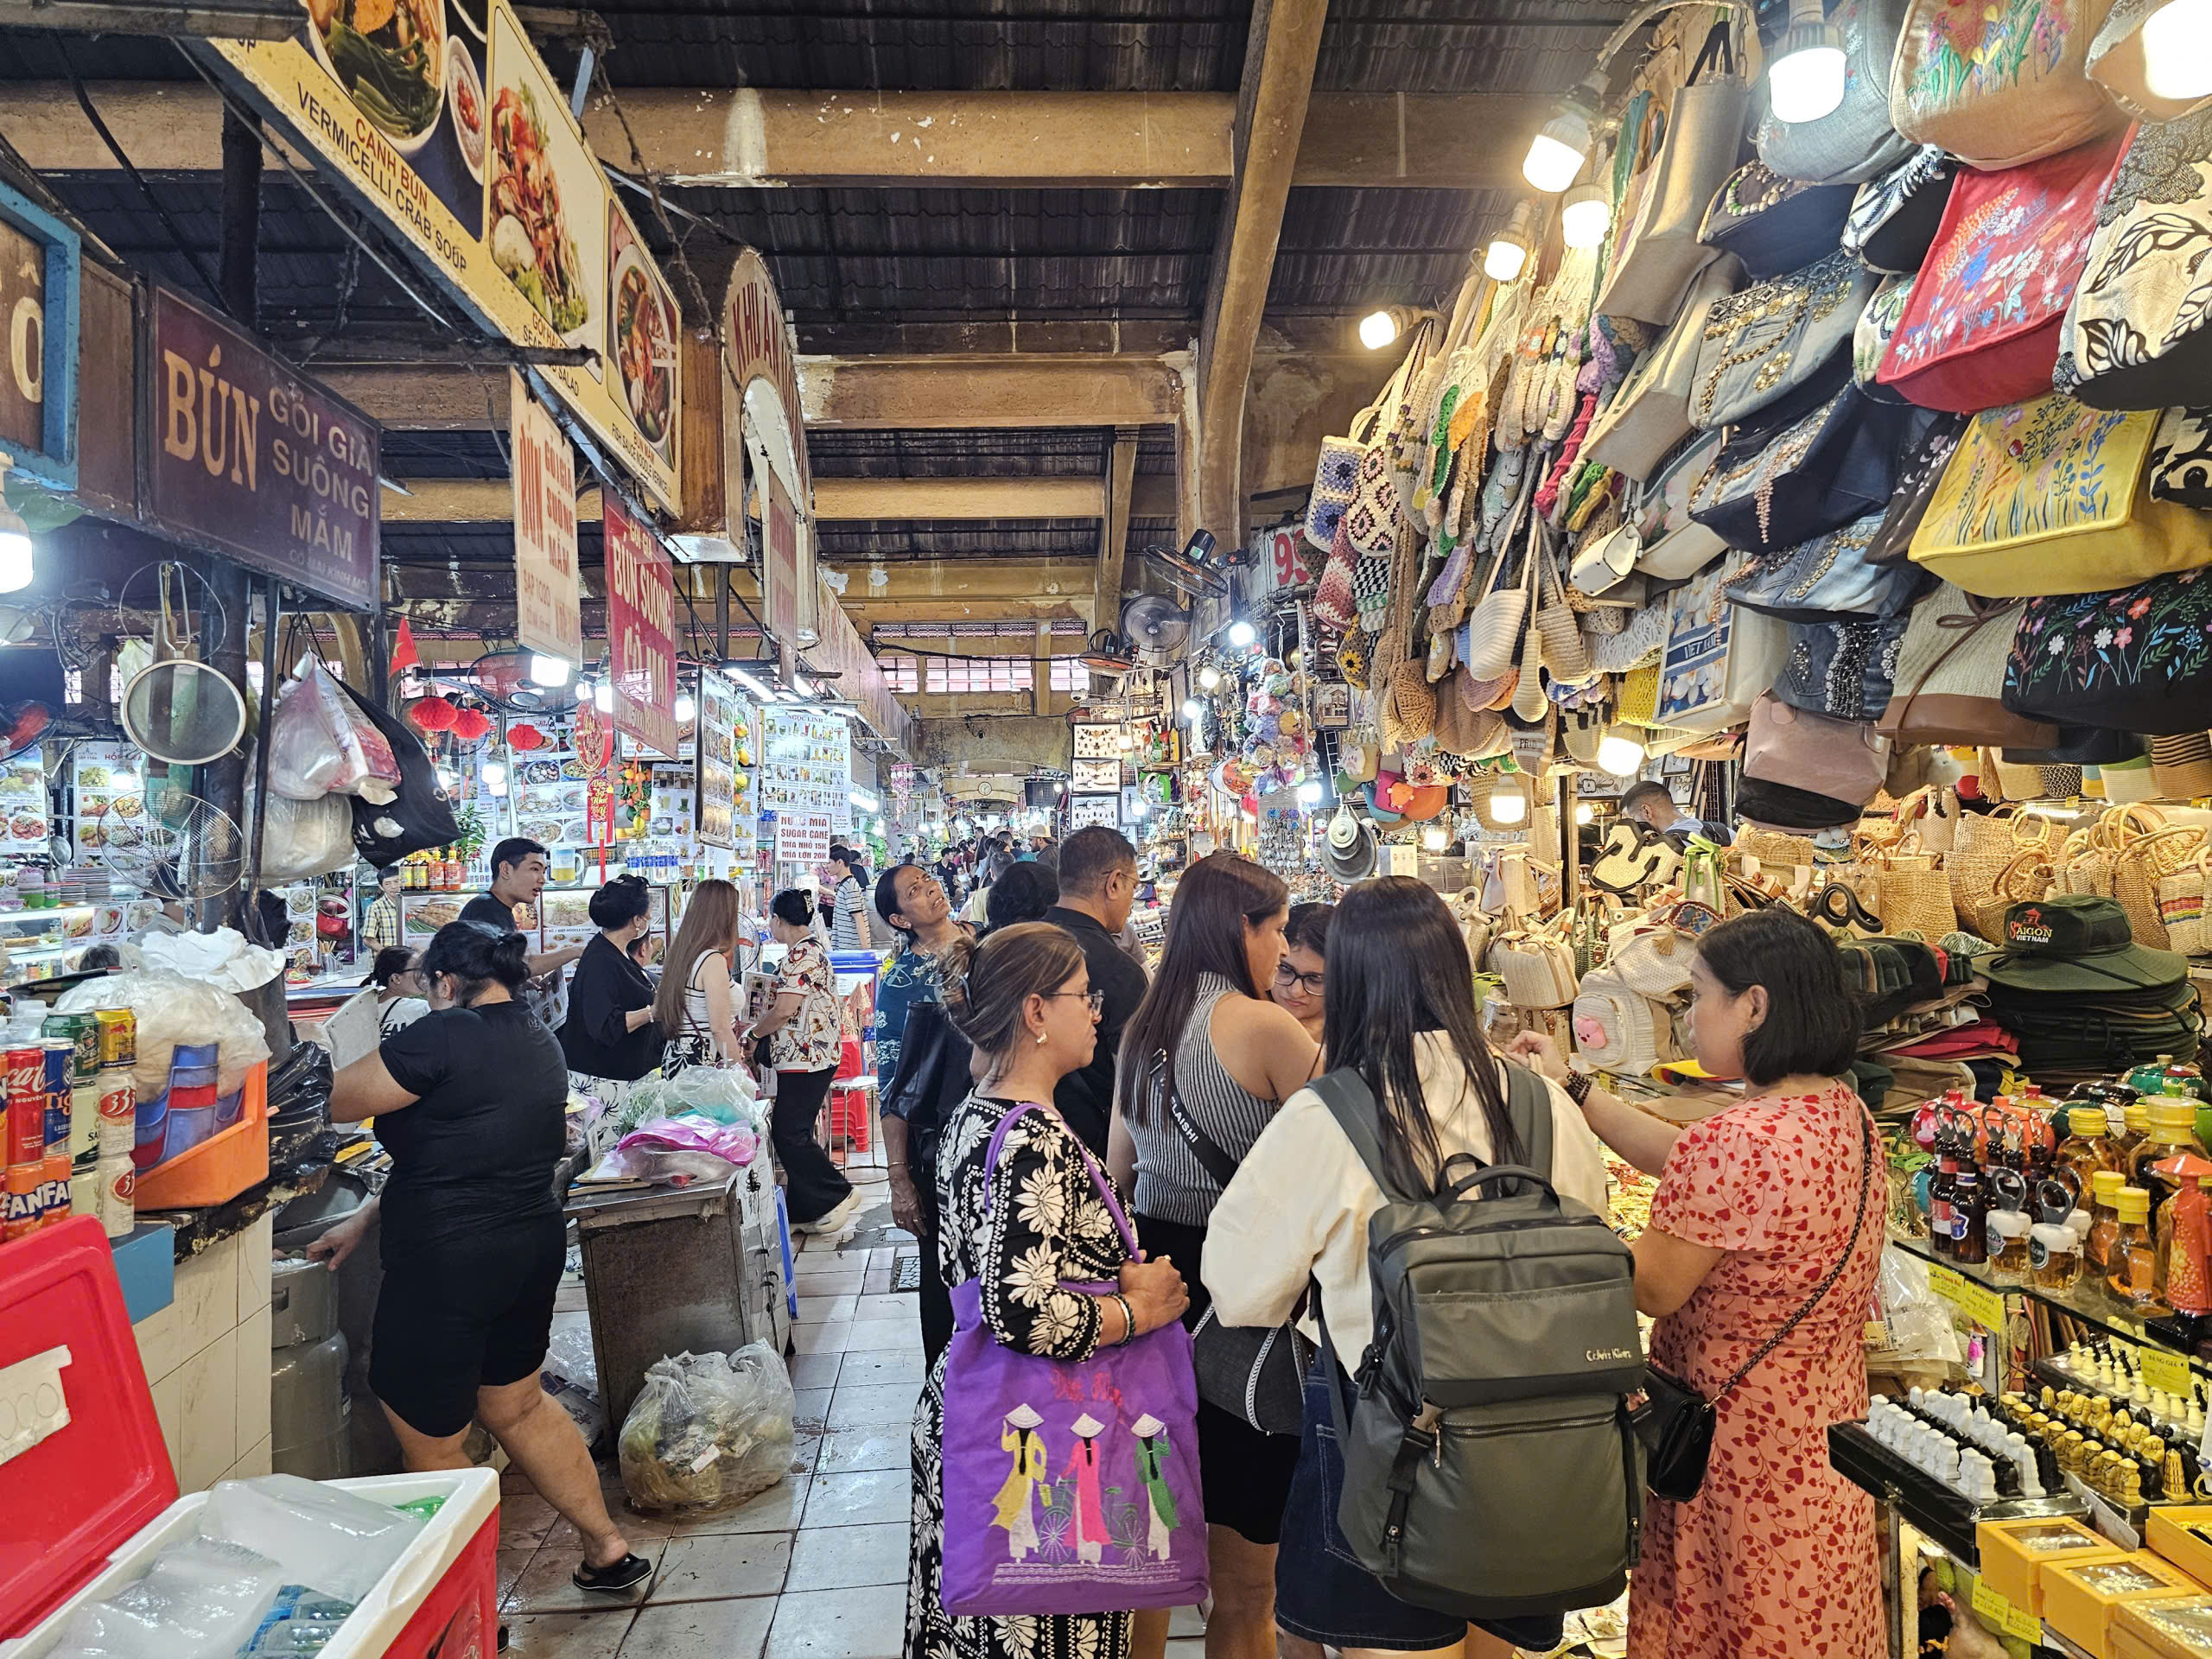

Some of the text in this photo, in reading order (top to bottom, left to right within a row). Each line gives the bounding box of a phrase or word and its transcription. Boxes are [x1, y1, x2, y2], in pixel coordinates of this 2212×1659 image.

[355, 118, 397, 175] CANH
[297, 81, 467, 273] VERMICELLI CRAB SOUP
[733, 283, 761, 382] KHU
[763, 279, 780, 386] ĂN
[558, 365, 580, 397] SALAD
[164, 344, 259, 492] BÚN
[270, 381, 319, 445] GỎI
[272, 438, 369, 518] SUÔNG
[612, 422, 622, 442] FISH
[622, 435, 636, 461] SAUCE
[636, 450, 652, 478] NOODLE
[519, 416, 544, 552] BÚN
[291, 504, 353, 562] MẮM
[546, 486, 574, 540] SUÔNG
[613, 532, 672, 643] BÚN SUÔNG
[787, 715, 806, 723] NGỌC
[781, 829, 829, 840] SUGAR CANE
[782, 840, 797, 849] MÍA
[798, 840, 813, 849] NHỎ
[809, 816, 827, 827] MÍA
[2010, 921, 2053, 939] SAIGON
[2016, 935, 2049, 944] VIETNAM
